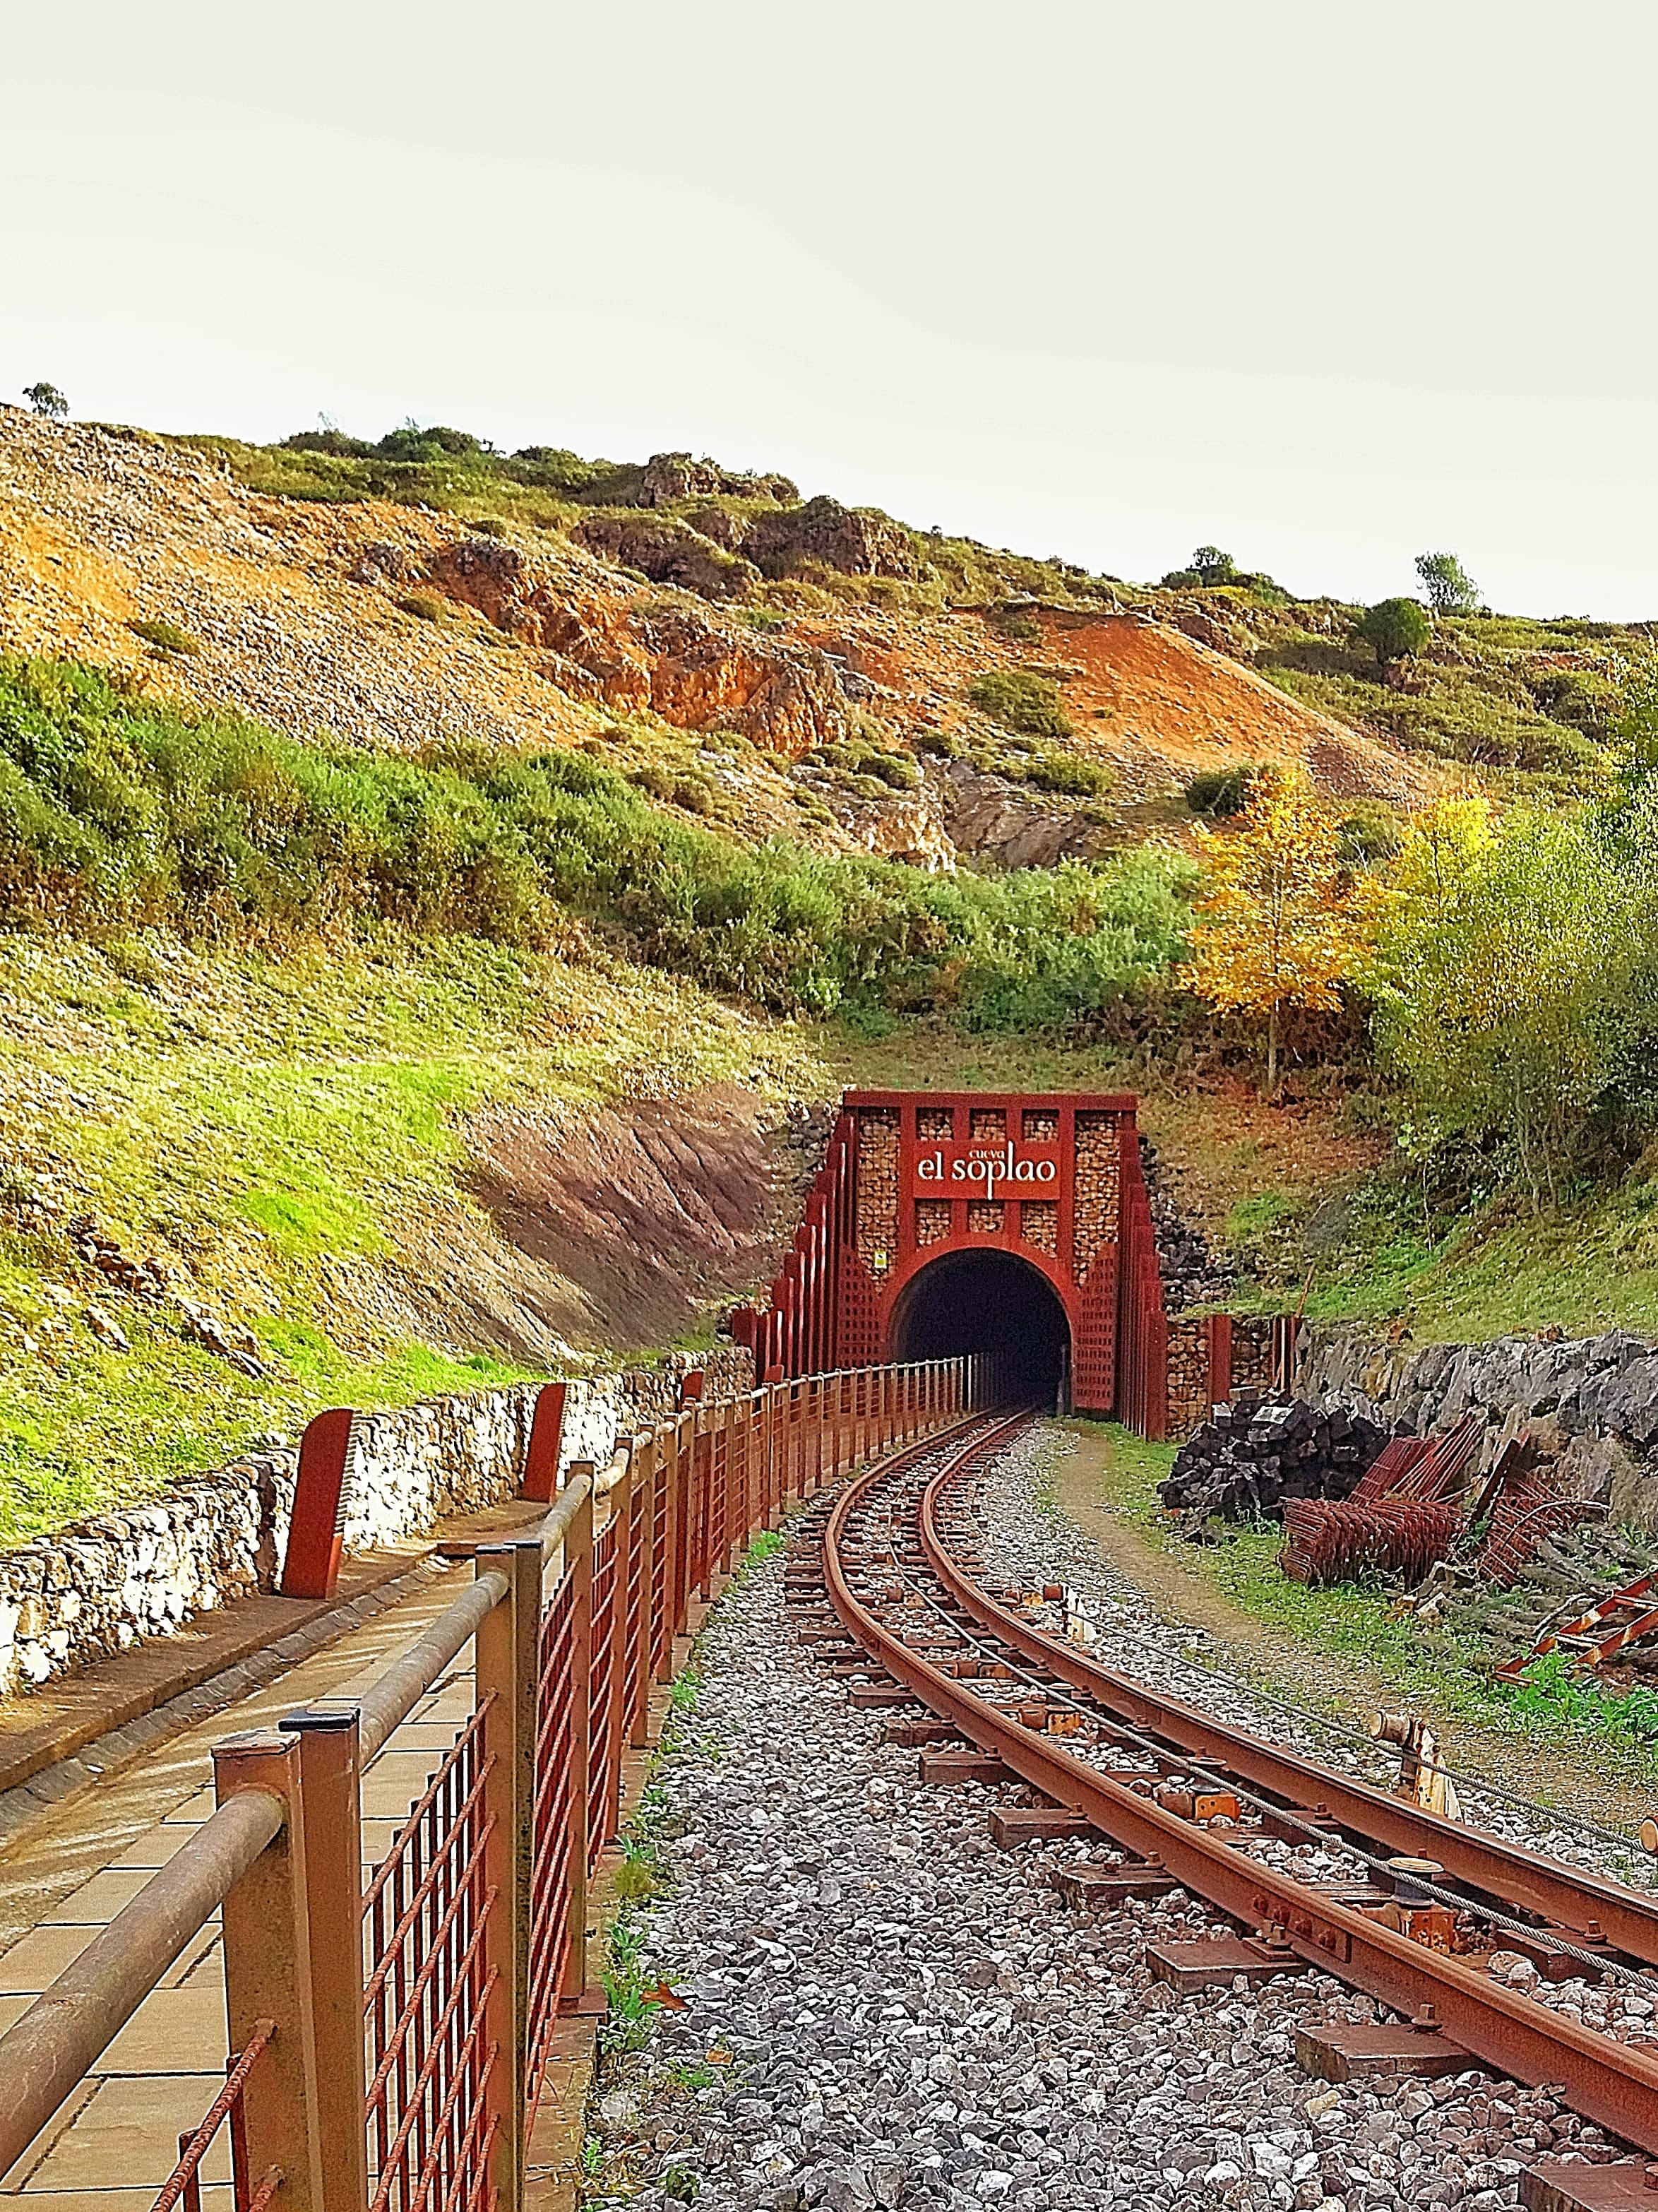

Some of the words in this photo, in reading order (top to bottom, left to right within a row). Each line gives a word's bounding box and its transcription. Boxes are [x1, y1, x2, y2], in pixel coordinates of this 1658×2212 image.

[918, 1151, 944, 1180] el
[951, 1141, 1056, 1200] soplao
[969, 1150, 1005, 1159] cueva
